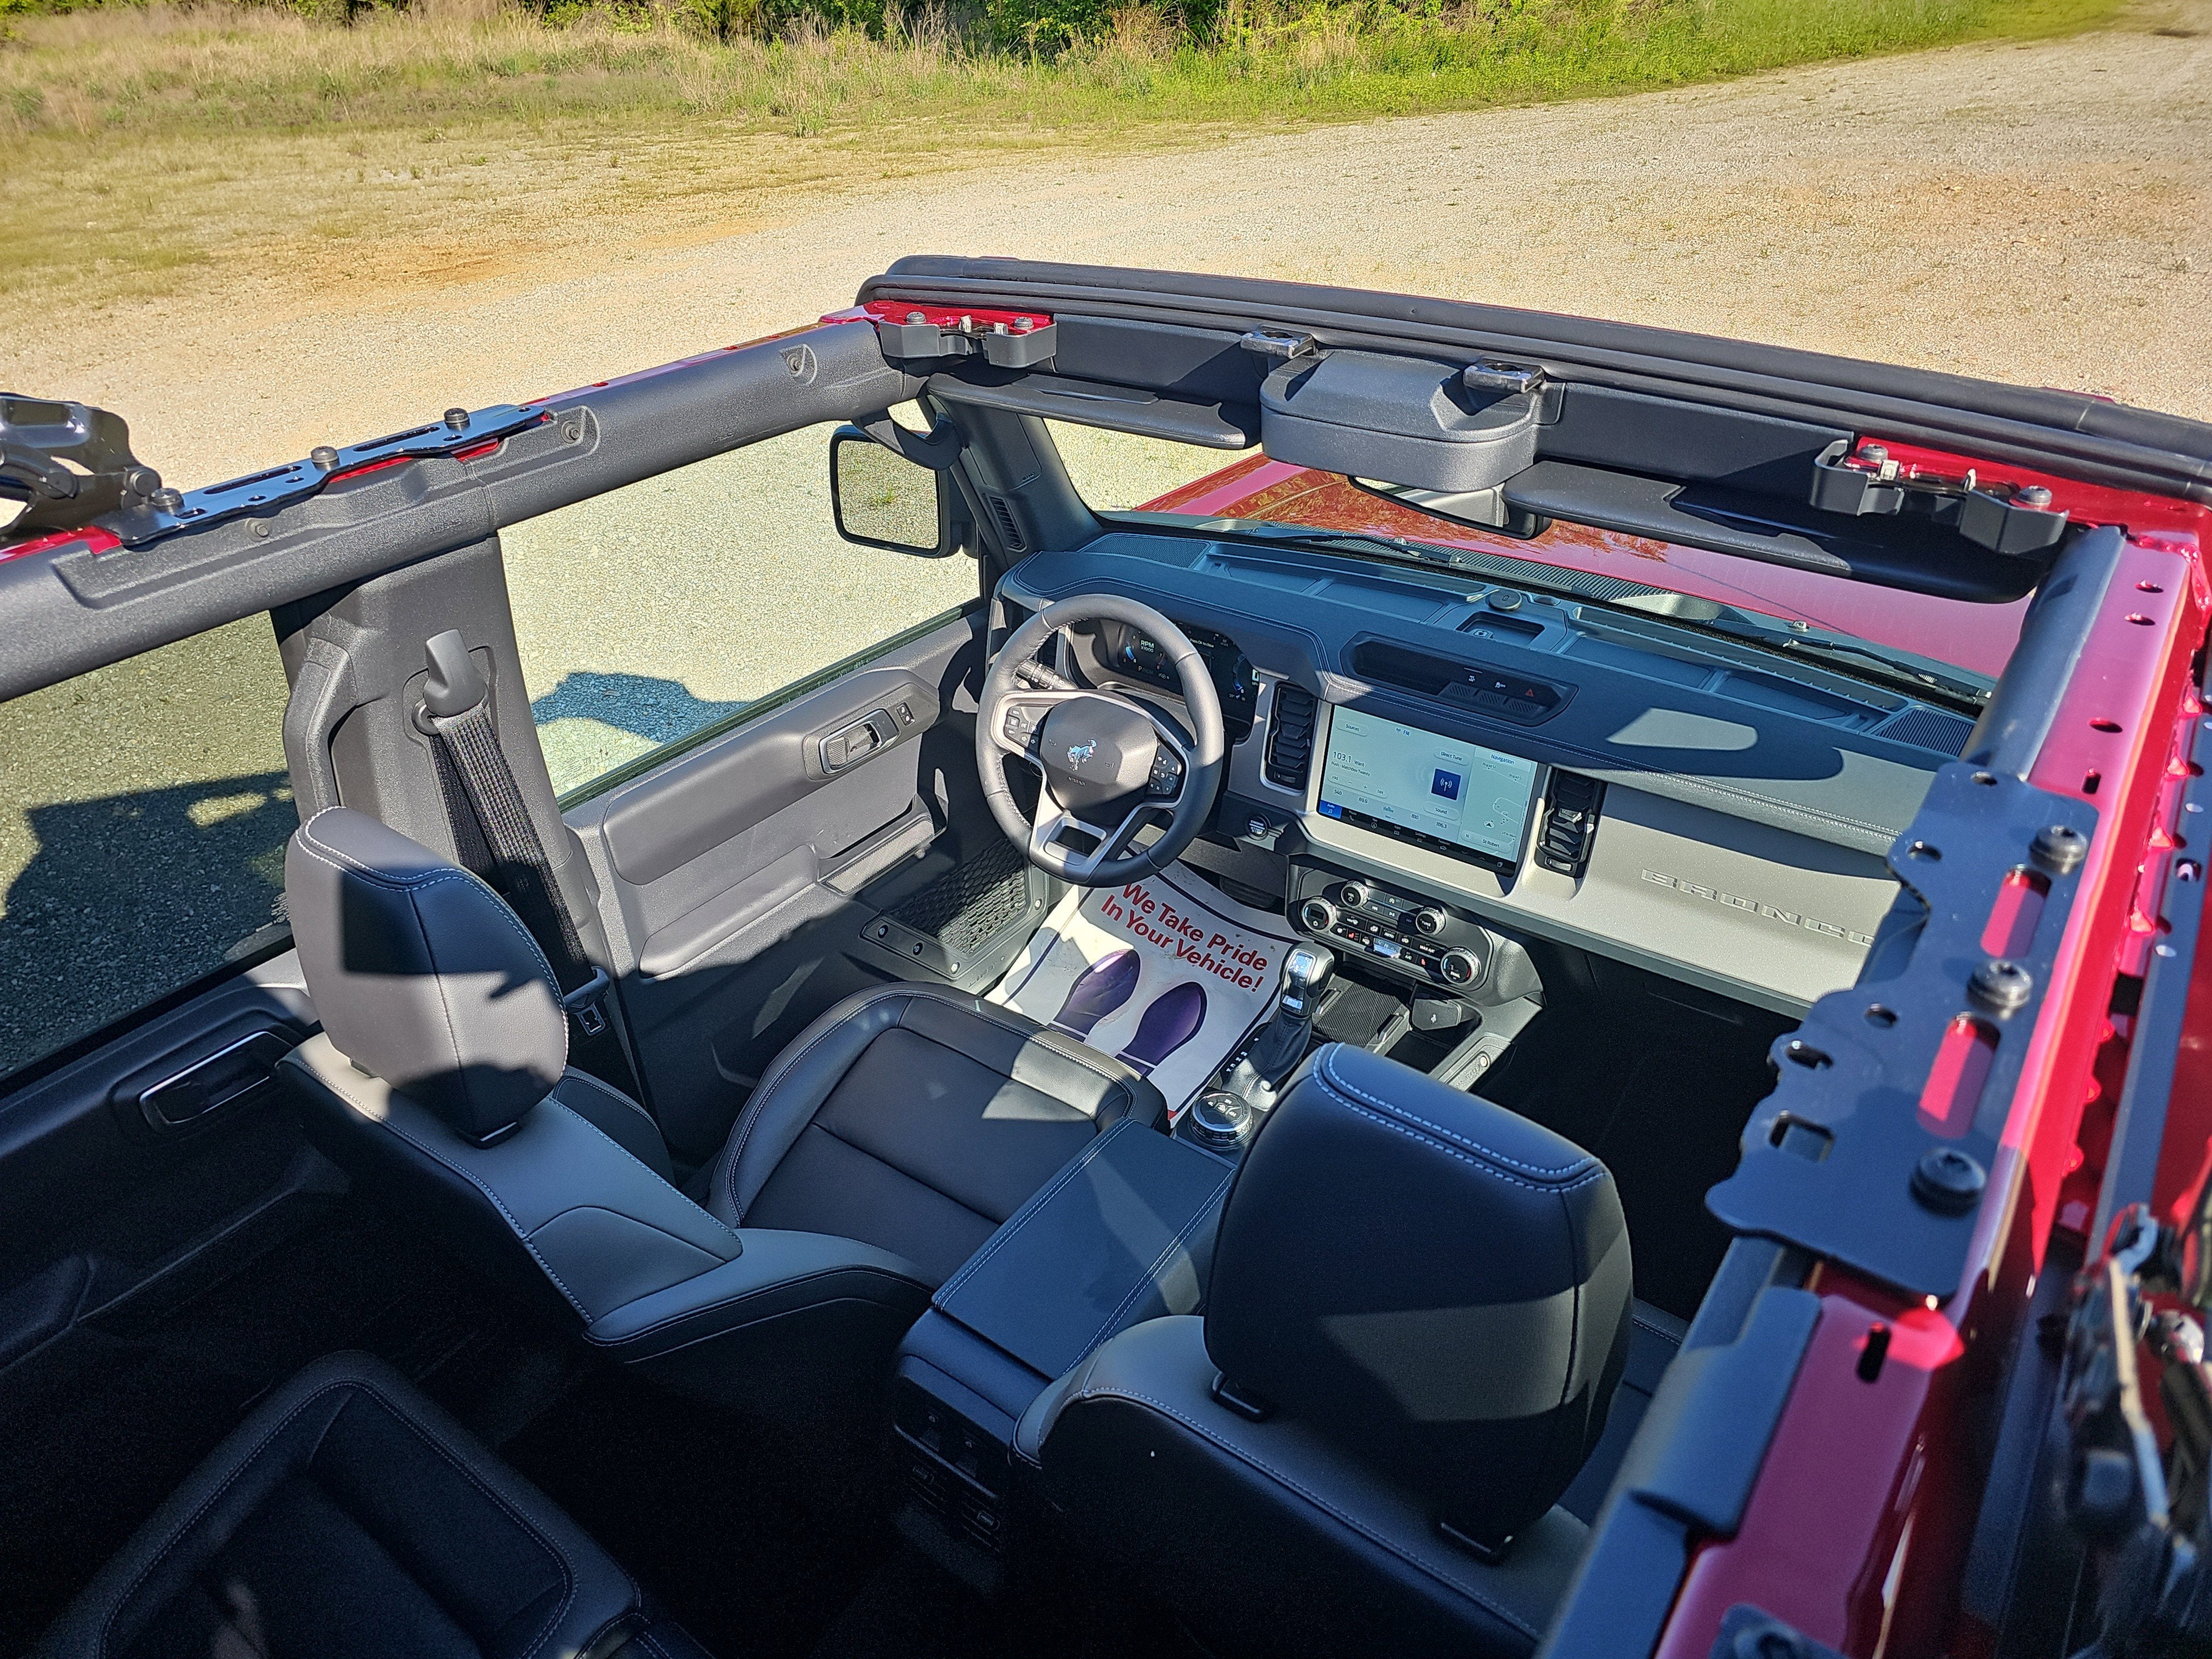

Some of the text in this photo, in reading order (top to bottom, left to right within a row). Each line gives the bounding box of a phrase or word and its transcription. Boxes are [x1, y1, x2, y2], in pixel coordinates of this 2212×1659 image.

[1345, 724, 1360, 732] Sources
[1333, 751, 1351, 763] 103.1
[1491, 754, 1514, 765] Navigation
[1122, 883, 1268, 971] We Take Pride
[1641, 869, 1875, 947] BRONCO
[1101, 895, 1264, 993] In Your Vehicle!
